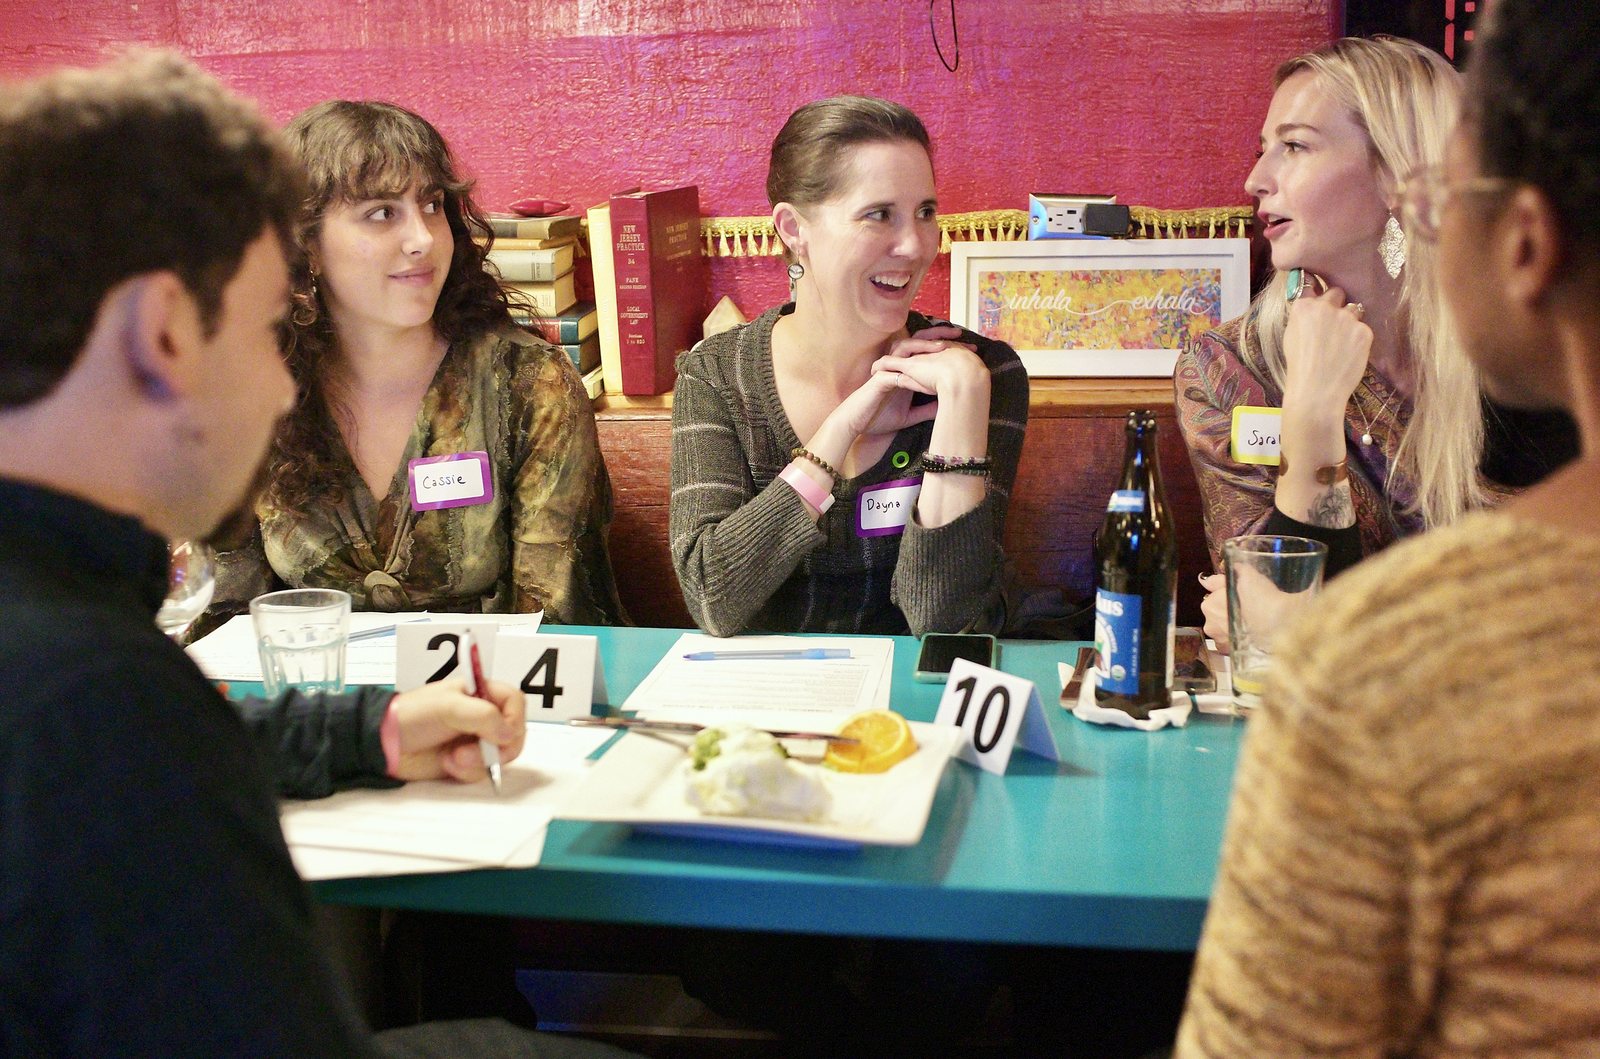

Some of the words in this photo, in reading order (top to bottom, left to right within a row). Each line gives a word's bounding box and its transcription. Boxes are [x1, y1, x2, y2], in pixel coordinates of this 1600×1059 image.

[623, 224, 637, 233] NEW
[619, 233, 641, 242] JERSEY
[616, 243, 645, 251] PRACTICE
[422, 474, 466, 490] Cassie
[866, 498, 901, 513] Dayna
[425, 632, 460, 685] 2
[520, 647, 563, 709] 4
[954, 676, 1010, 754] 10
